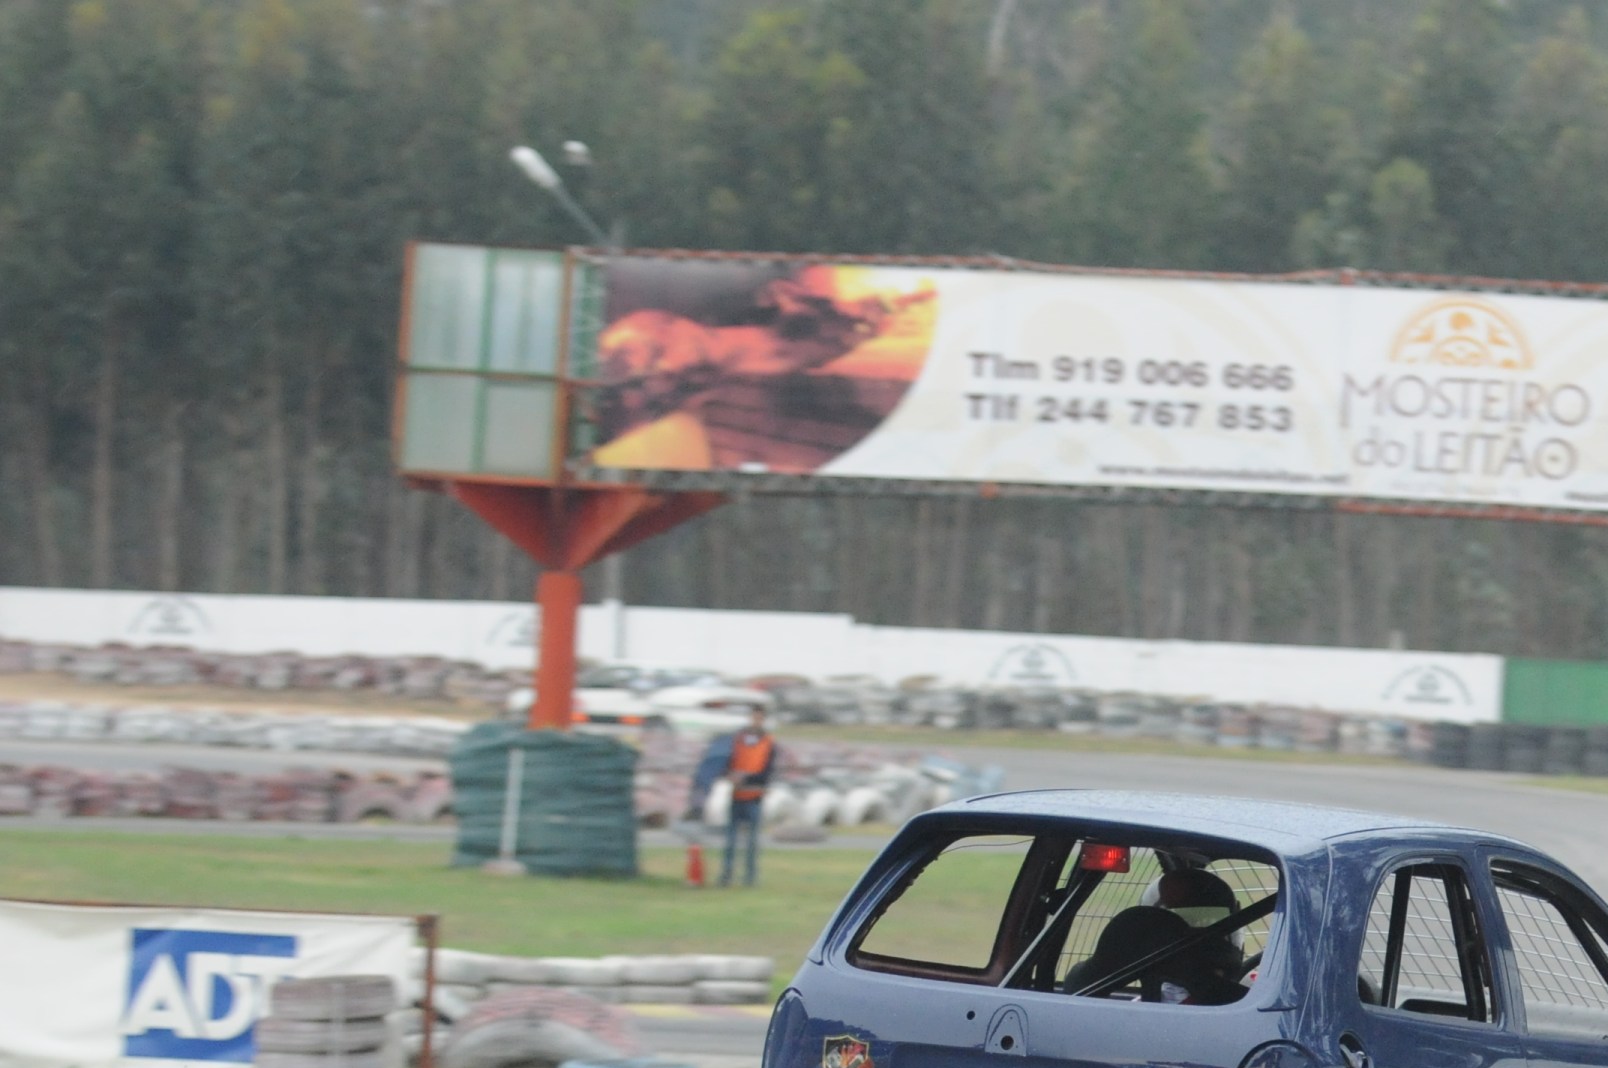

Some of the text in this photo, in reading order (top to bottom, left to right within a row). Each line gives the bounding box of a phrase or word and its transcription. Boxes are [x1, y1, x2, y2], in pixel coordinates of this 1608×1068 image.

[967, 352, 1294, 392] Tlm 919 006 666
[1035, 396, 1109, 424] 244
[1128, 400, 1200, 429] 767
[1217, 403, 1294, 432] 853
[1339, 373, 1592, 430] MOSTEIRO
[1352, 425, 1579, 481] do LEITÃO
[122, 952, 297, 1040] ADT
